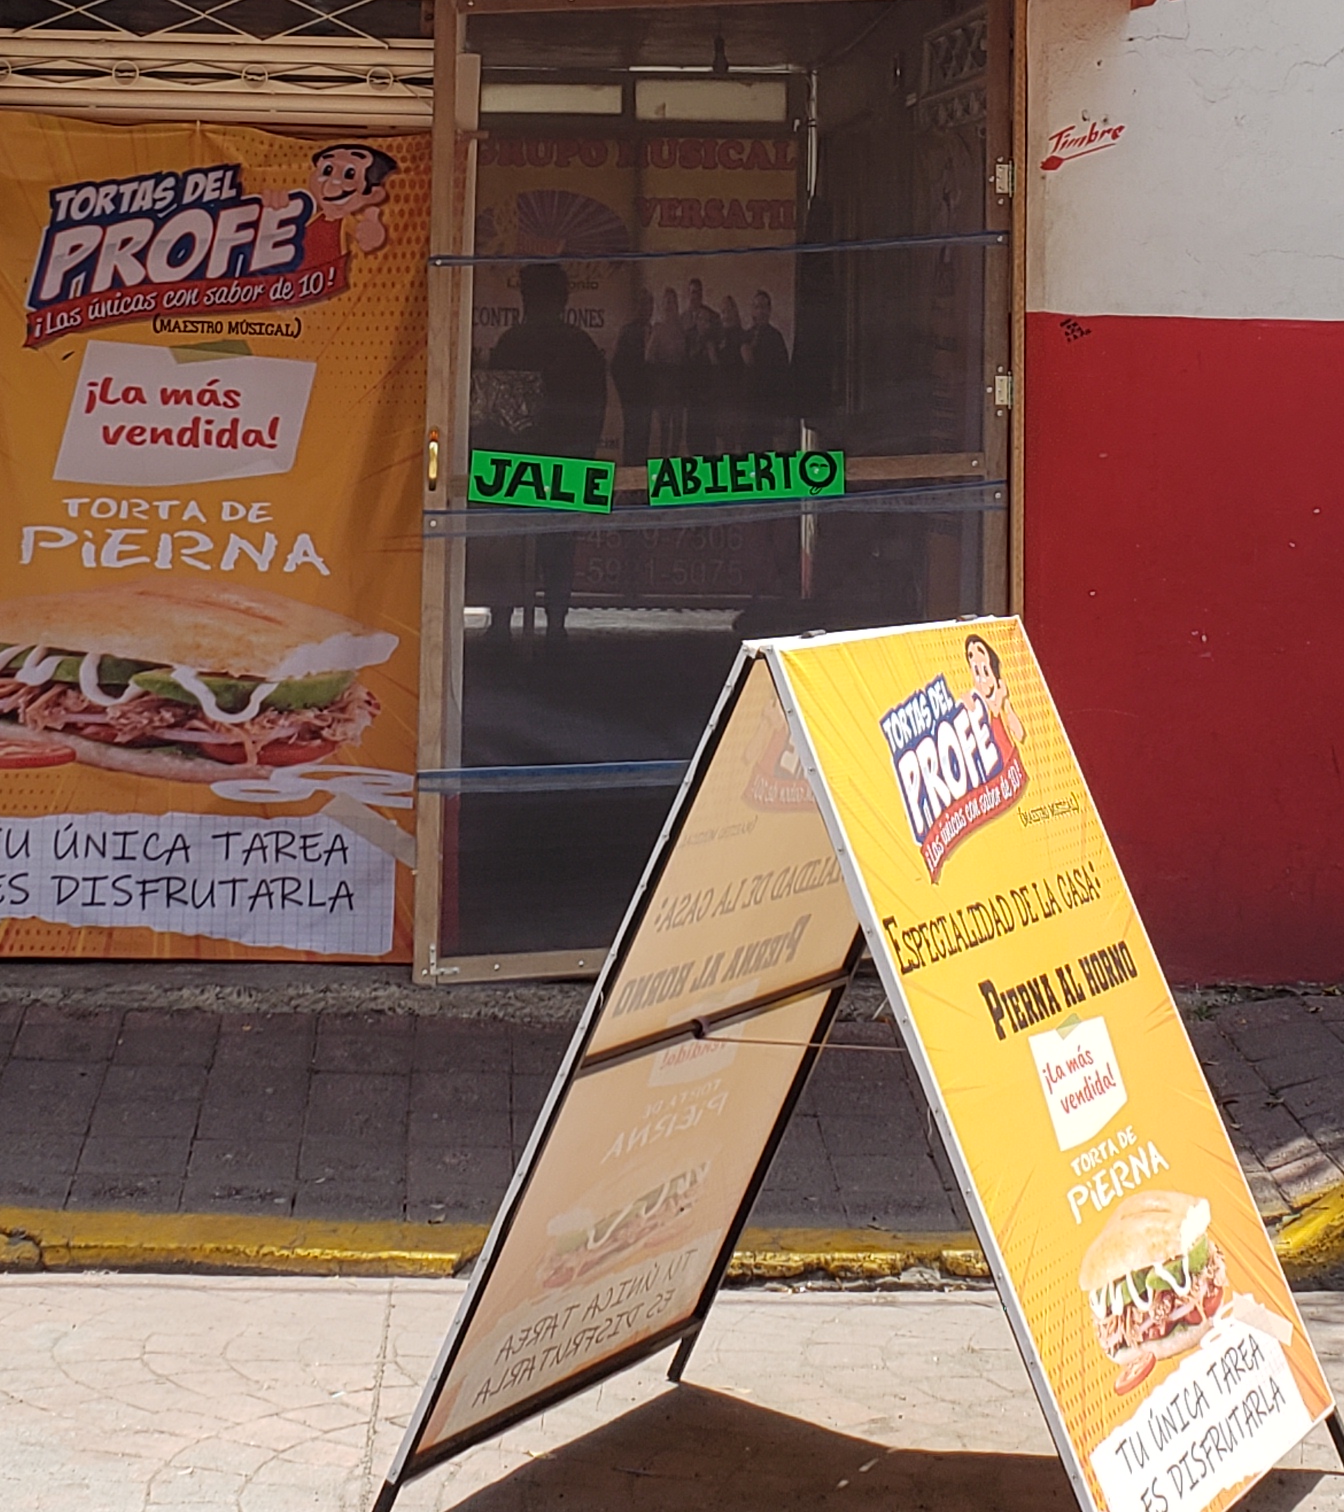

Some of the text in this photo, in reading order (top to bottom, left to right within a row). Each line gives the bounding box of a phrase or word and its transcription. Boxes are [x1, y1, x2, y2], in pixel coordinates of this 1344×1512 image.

[1048, 122, 1126, 154] Timbre
[55, 169, 237, 222] TORTAS DEL
[40, 197, 305, 302] PROFE
[35, 267, 335, 338] ¡Las únicas con sabor de 10!
[152, 313, 224, 335] (MAESTRO
[84, 377, 242, 414] ¡La más
[101, 417, 281, 449] vendida!
[474, 451, 838, 505] JALE ABIERTO
[62, 498, 274, 523] TORTA DE
[883, 679, 954, 753] TORTAS DEL
[898, 697, 999, 836] PROFE
[54, 822, 192, 864] ÚNICA
[212, 830, 350, 866] TAREA
[51, 875, 355, 913] DISFRUTARLA
[1009, 884, 1040, 927] DE
[1031, 878, 1062, 919] LA
[1056, 860, 1101, 909] CASA:
[1054, 963, 1087, 1008] AL
[1077, 940, 1139, 997] HORNO
[1042, 1044, 1094, 1095] ¡La más
[1060, 1062, 1117, 1114] vendida!
[1070, 1125, 1138, 1177] TORTA DE
[1114, 1333, 1267, 1474] TU ÚNICA TAREA
[1140, 1375, 1287, 1512] ES DISFRUTARLA
